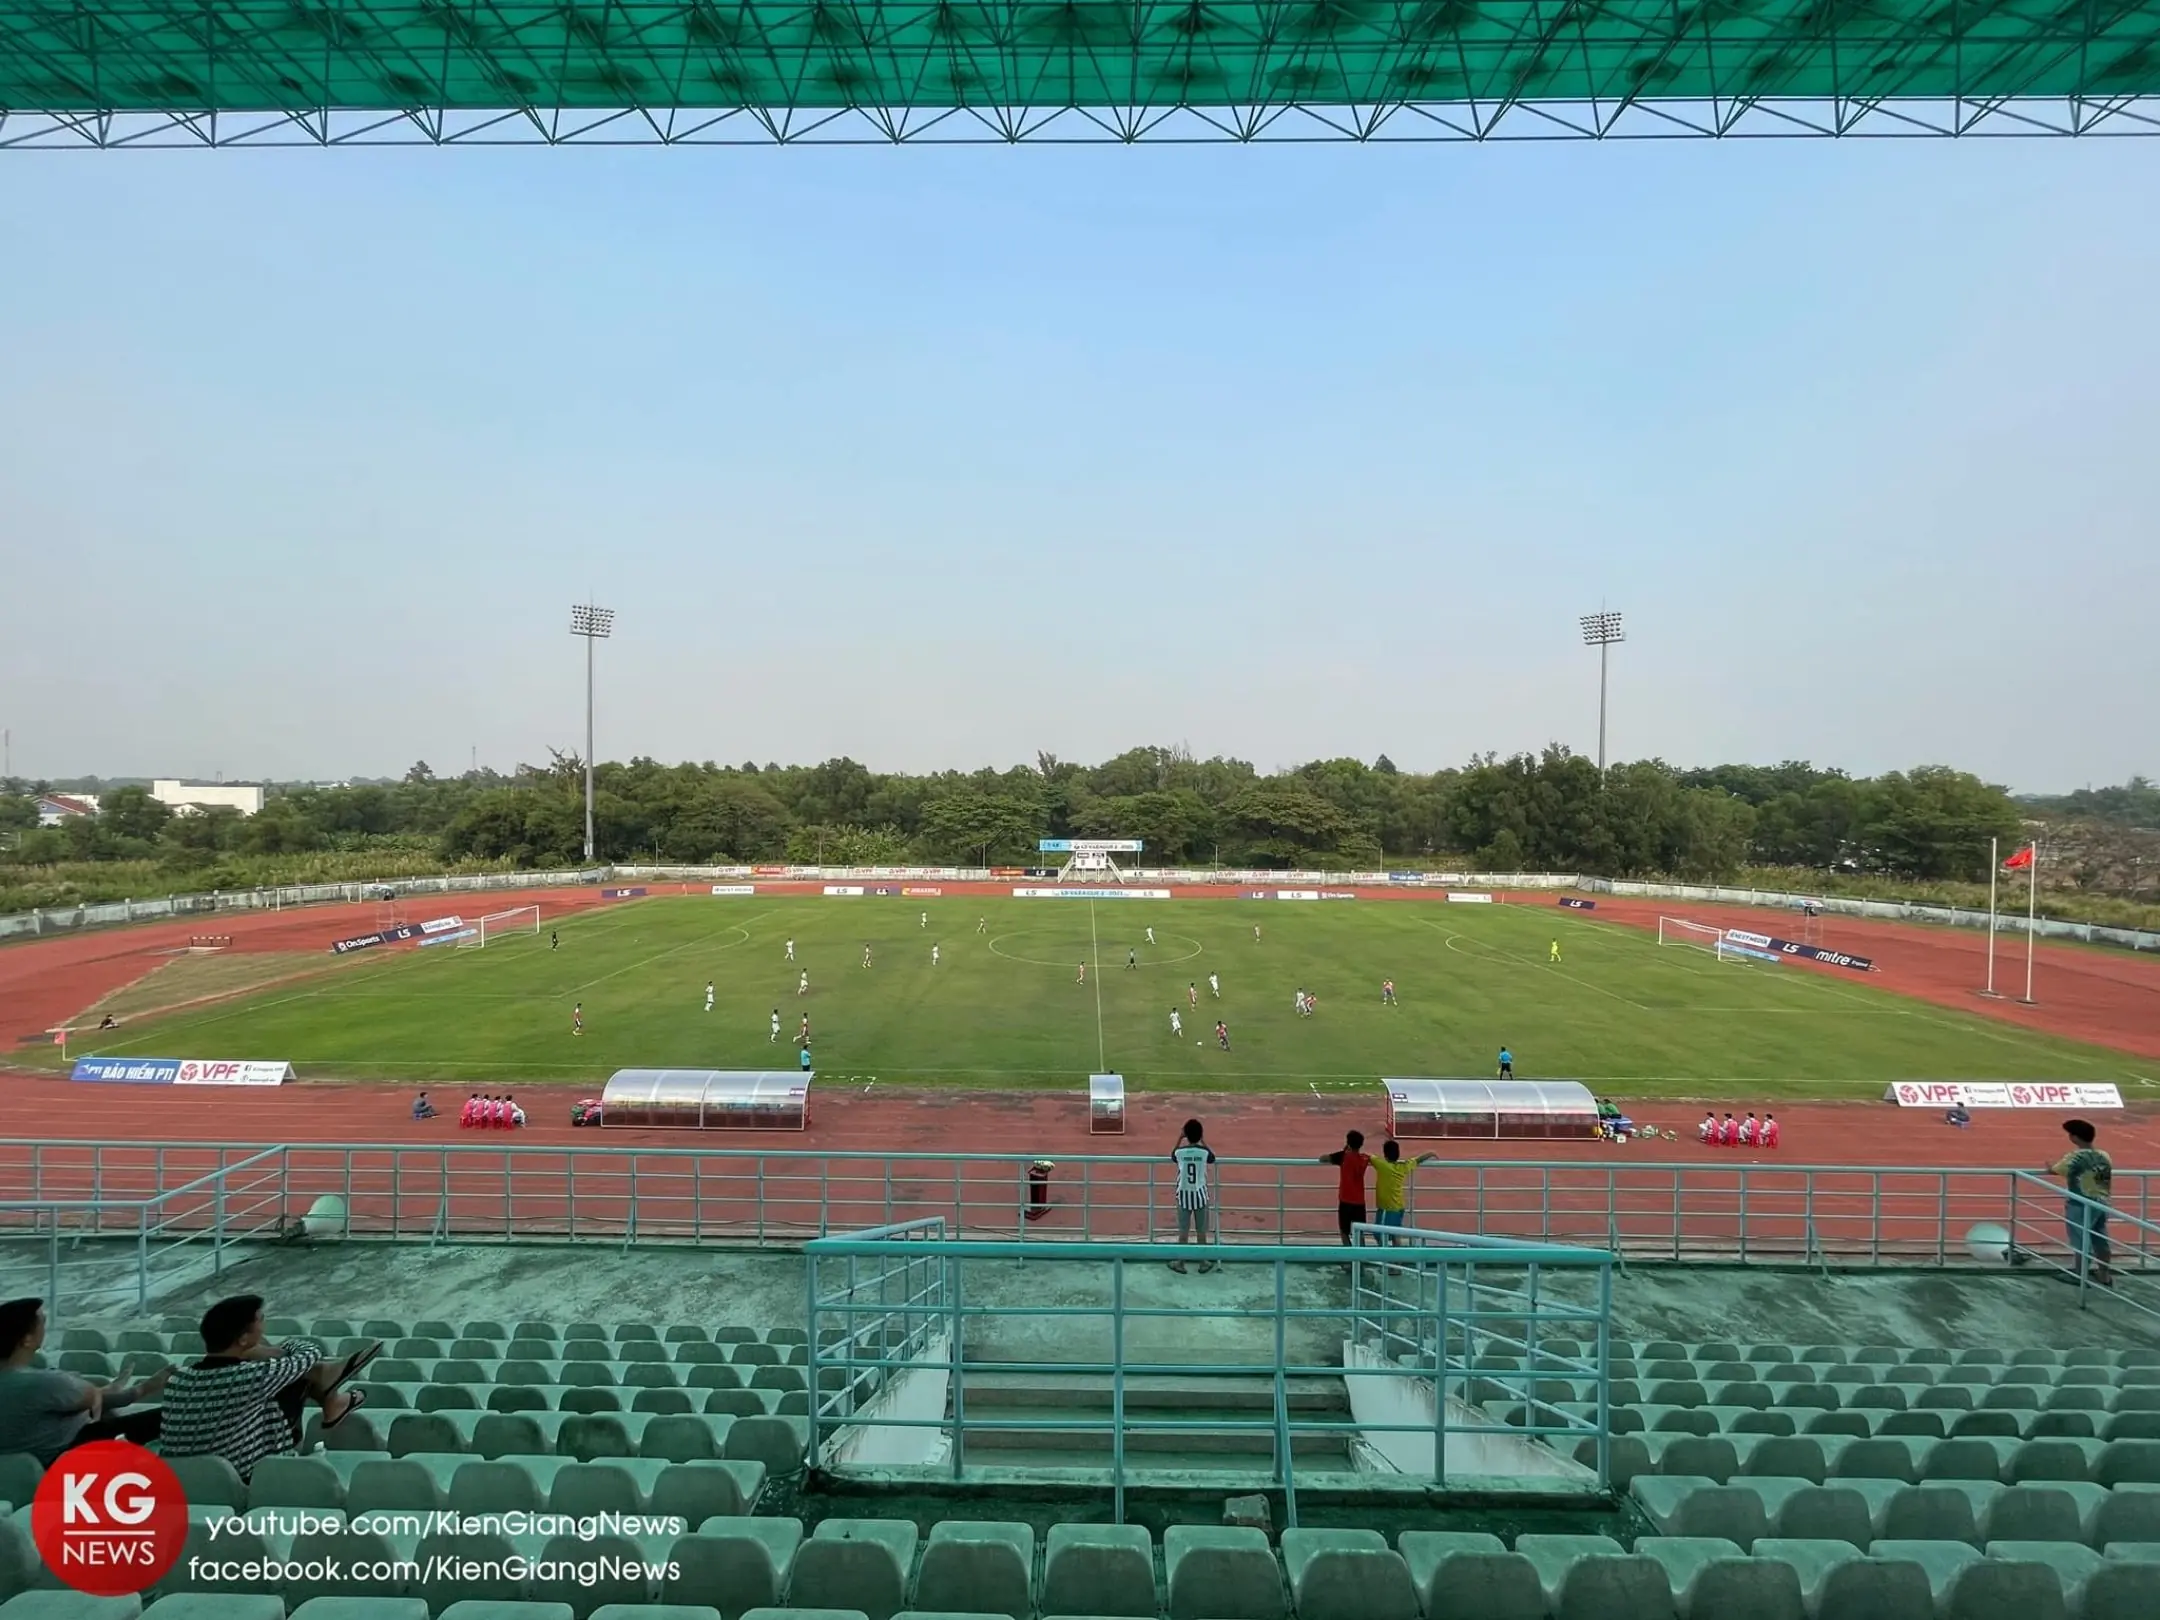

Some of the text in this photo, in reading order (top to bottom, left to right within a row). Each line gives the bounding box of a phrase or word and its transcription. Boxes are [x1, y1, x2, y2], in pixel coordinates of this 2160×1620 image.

[616, 889, 632, 897] LS
[1569, 899, 1582, 907] LS
[397, 928, 411, 939] LS
[1782, 943, 1800, 953] LS
[1815, 950, 1851, 965] mitre
[155, 1067, 175, 1081] PTI
[203, 1063, 241, 1079] VPF
[1918, 1085, 1959, 1101] VPF
[2030, 1086, 2071, 1102] VPF
[1187, 1163, 1196, 1184] 9
